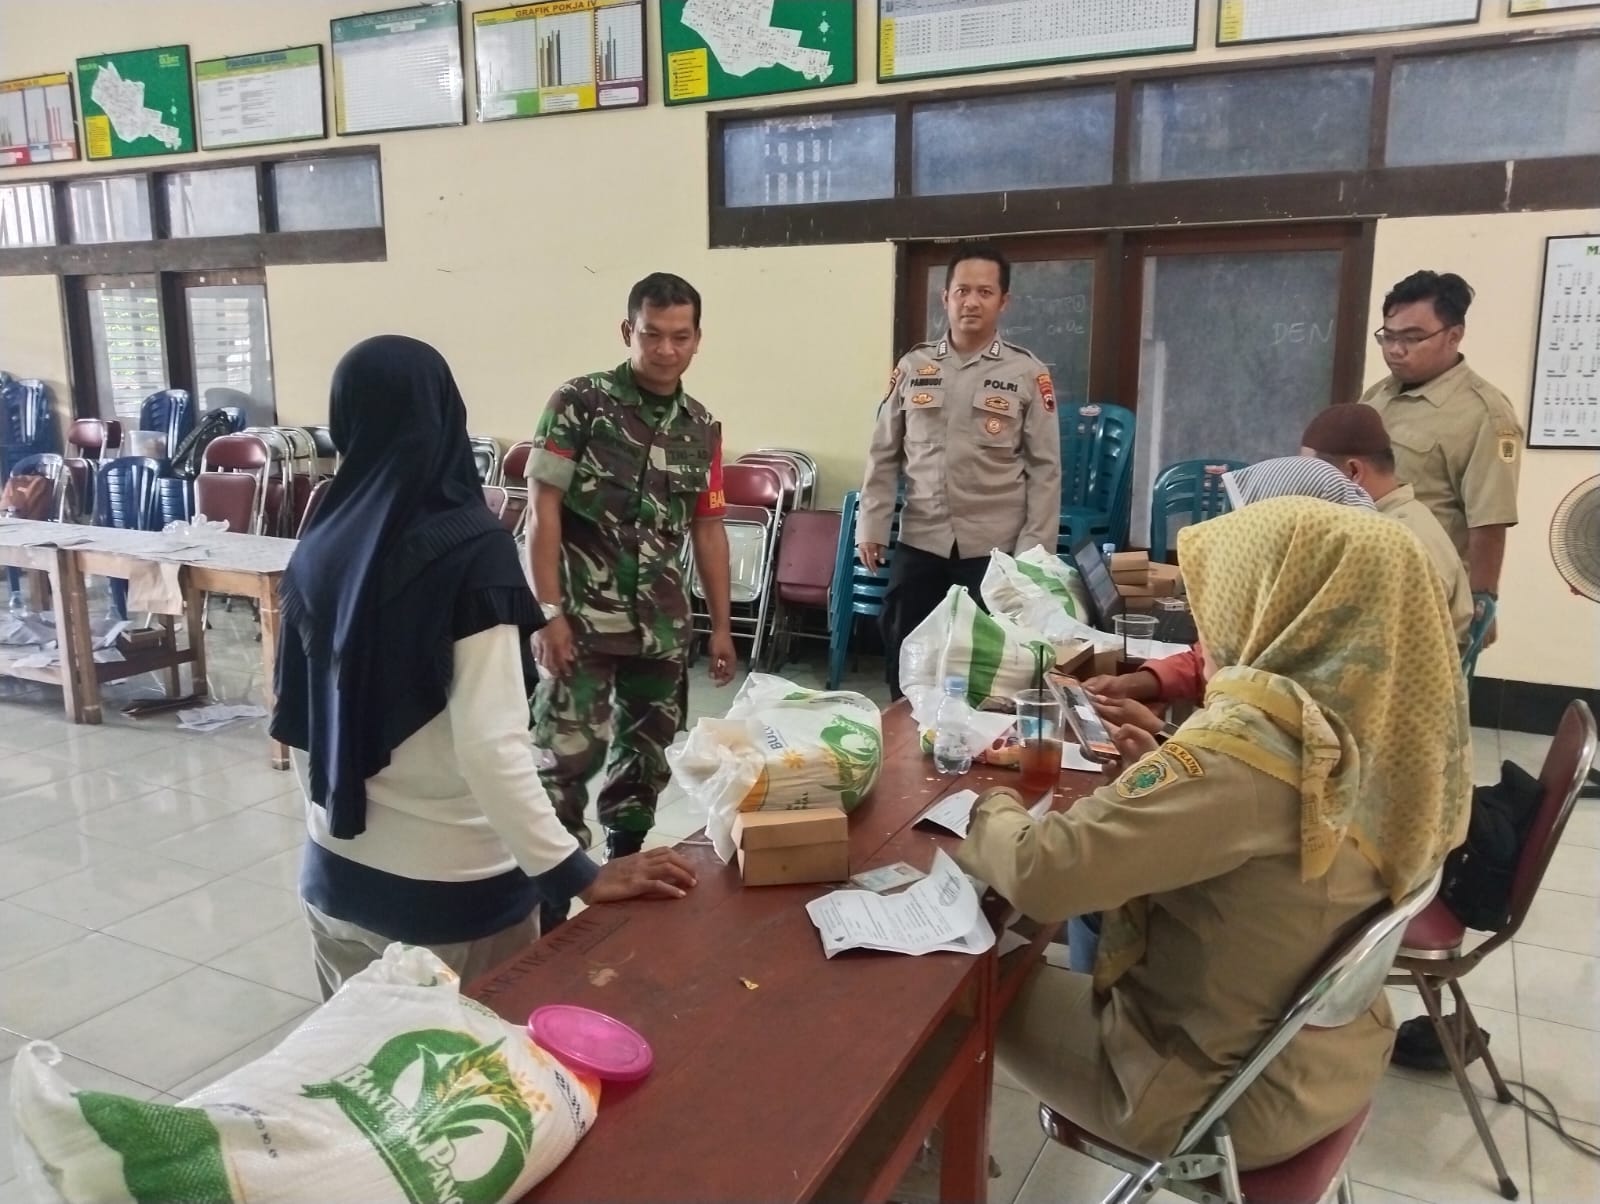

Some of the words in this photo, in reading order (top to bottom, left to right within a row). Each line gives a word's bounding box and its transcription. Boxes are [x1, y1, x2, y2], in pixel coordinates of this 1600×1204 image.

[515, 6, 550, 18] GRAFIK
[552, 1, 584, 13] POKJA
[587, 0, 598, 8] IV
[1270, 319, 1334, 345] DEN
[983, 378, 1019, 393] POLRI
[1179, 750, 1200, 775] KLATEN
[331, 1064, 424, 1146] BANTUAN
